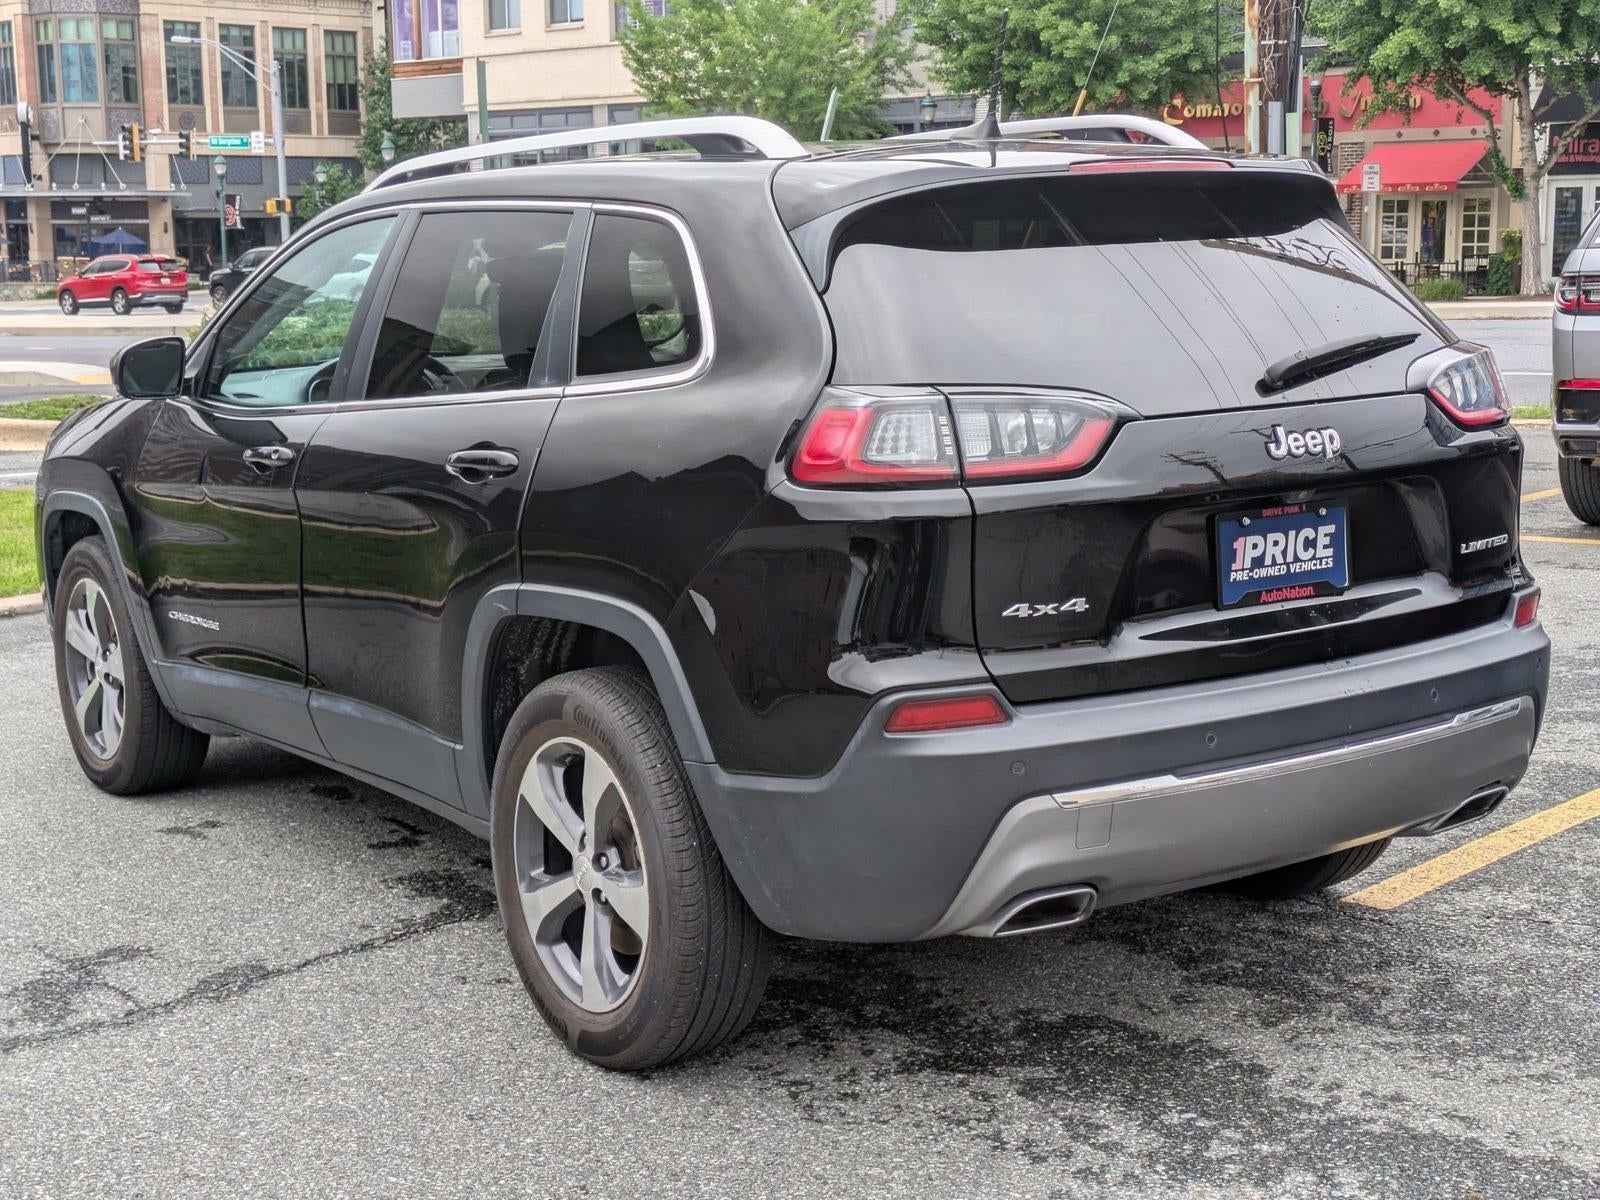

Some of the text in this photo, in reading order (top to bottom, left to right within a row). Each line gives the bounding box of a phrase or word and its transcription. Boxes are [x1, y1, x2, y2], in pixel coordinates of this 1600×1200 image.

[1264, 424, 1341, 461] Jeep
[1262, 505, 1300, 517] DRIVE PINK
[1460, 533, 1508, 554] LIMITED
[1230, 558, 1333, 582] PRE-OWNED VEHICLES
[1260, 585, 1315, 603] AutoNation
[168, 610, 220, 631] CHEROKEE
